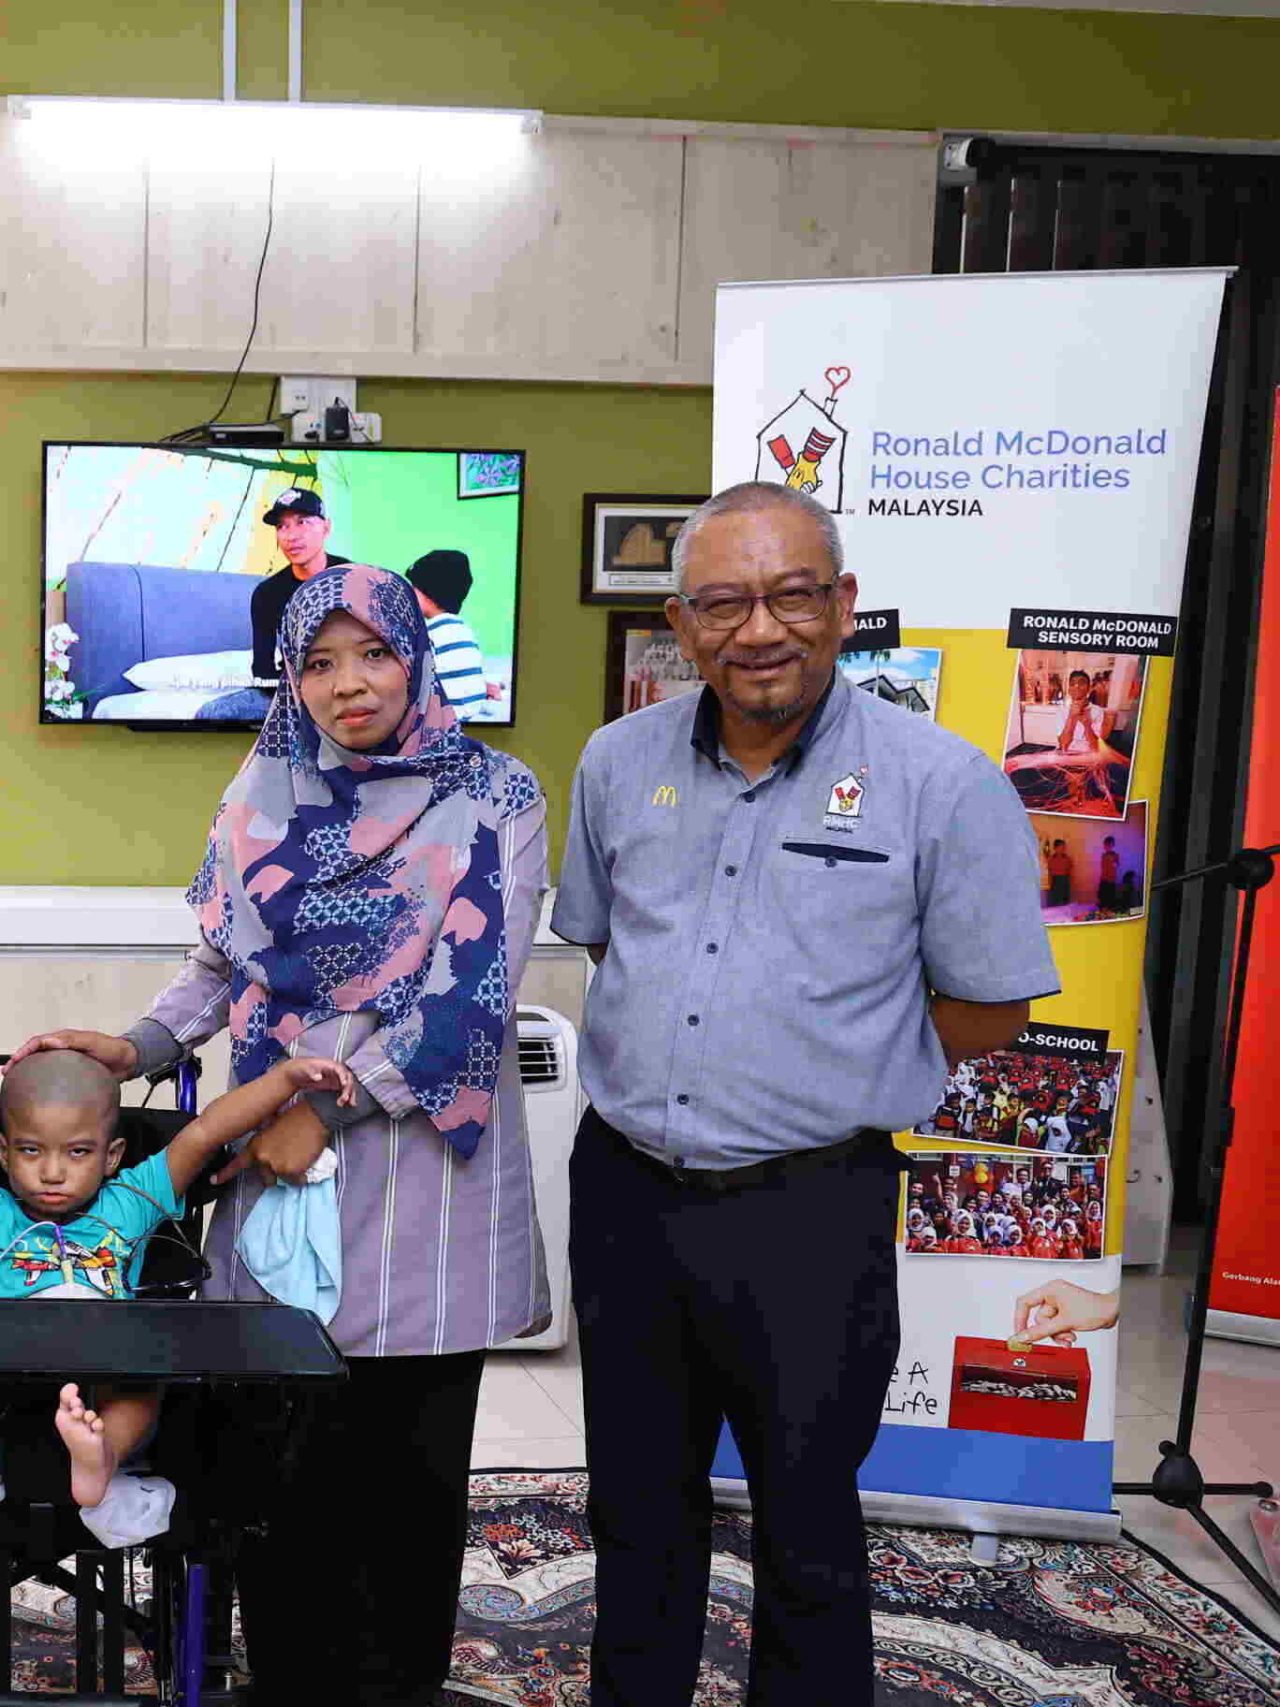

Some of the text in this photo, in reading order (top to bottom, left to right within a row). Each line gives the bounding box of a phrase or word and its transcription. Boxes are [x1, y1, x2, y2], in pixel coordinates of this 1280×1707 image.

[872, 428, 1166, 457] Ronald McDonald
[870, 463, 1130, 490] House Charities
[868, 499, 983, 517] MALAYSIA
[1023, 615, 1172, 635] RONALD McDONALD
[1038, 631, 1159, 649] SENSORY ROOM
[908, 1361, 928, 1385] A
[885, 1391, 937, 1415] Life
